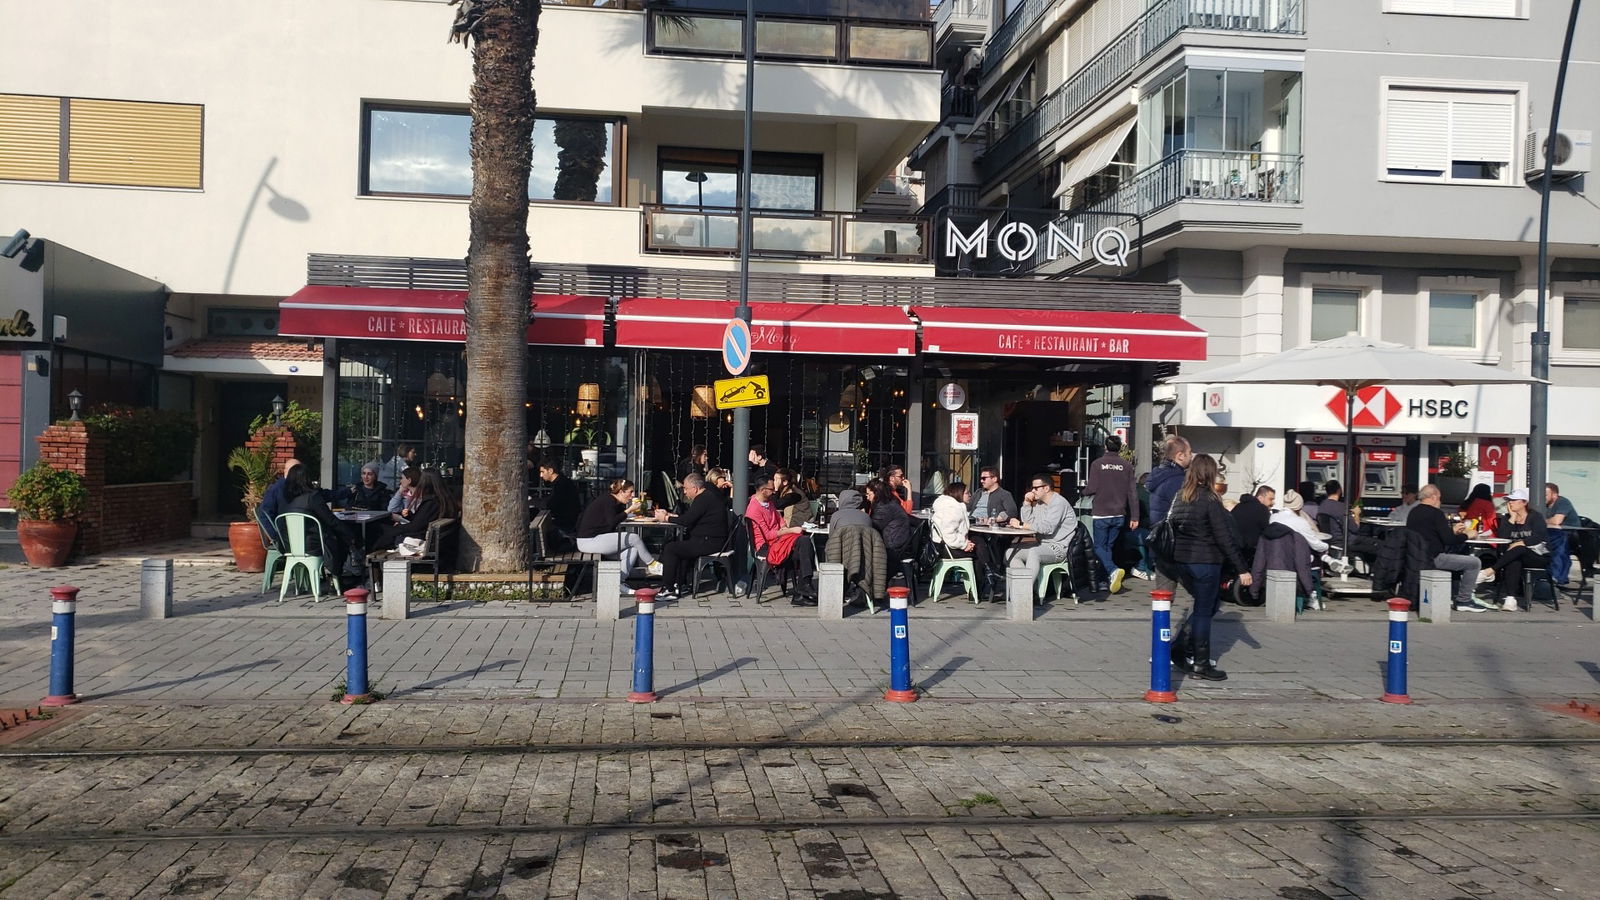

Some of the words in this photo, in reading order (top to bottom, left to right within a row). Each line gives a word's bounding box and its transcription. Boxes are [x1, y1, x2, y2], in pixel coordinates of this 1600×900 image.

[945, 216, 1131, 267] MONQ
[367, 316, 396, 333] CAFE
[408, 318, 467, 335] RESTAURA
[998, 334, 1023, 349] CAFE
[1034, 335, 1099, 352] RESTAURANT
[1109, 338, 1129, 353] BAR
[1408, 398, 1469, 418] HSBC
